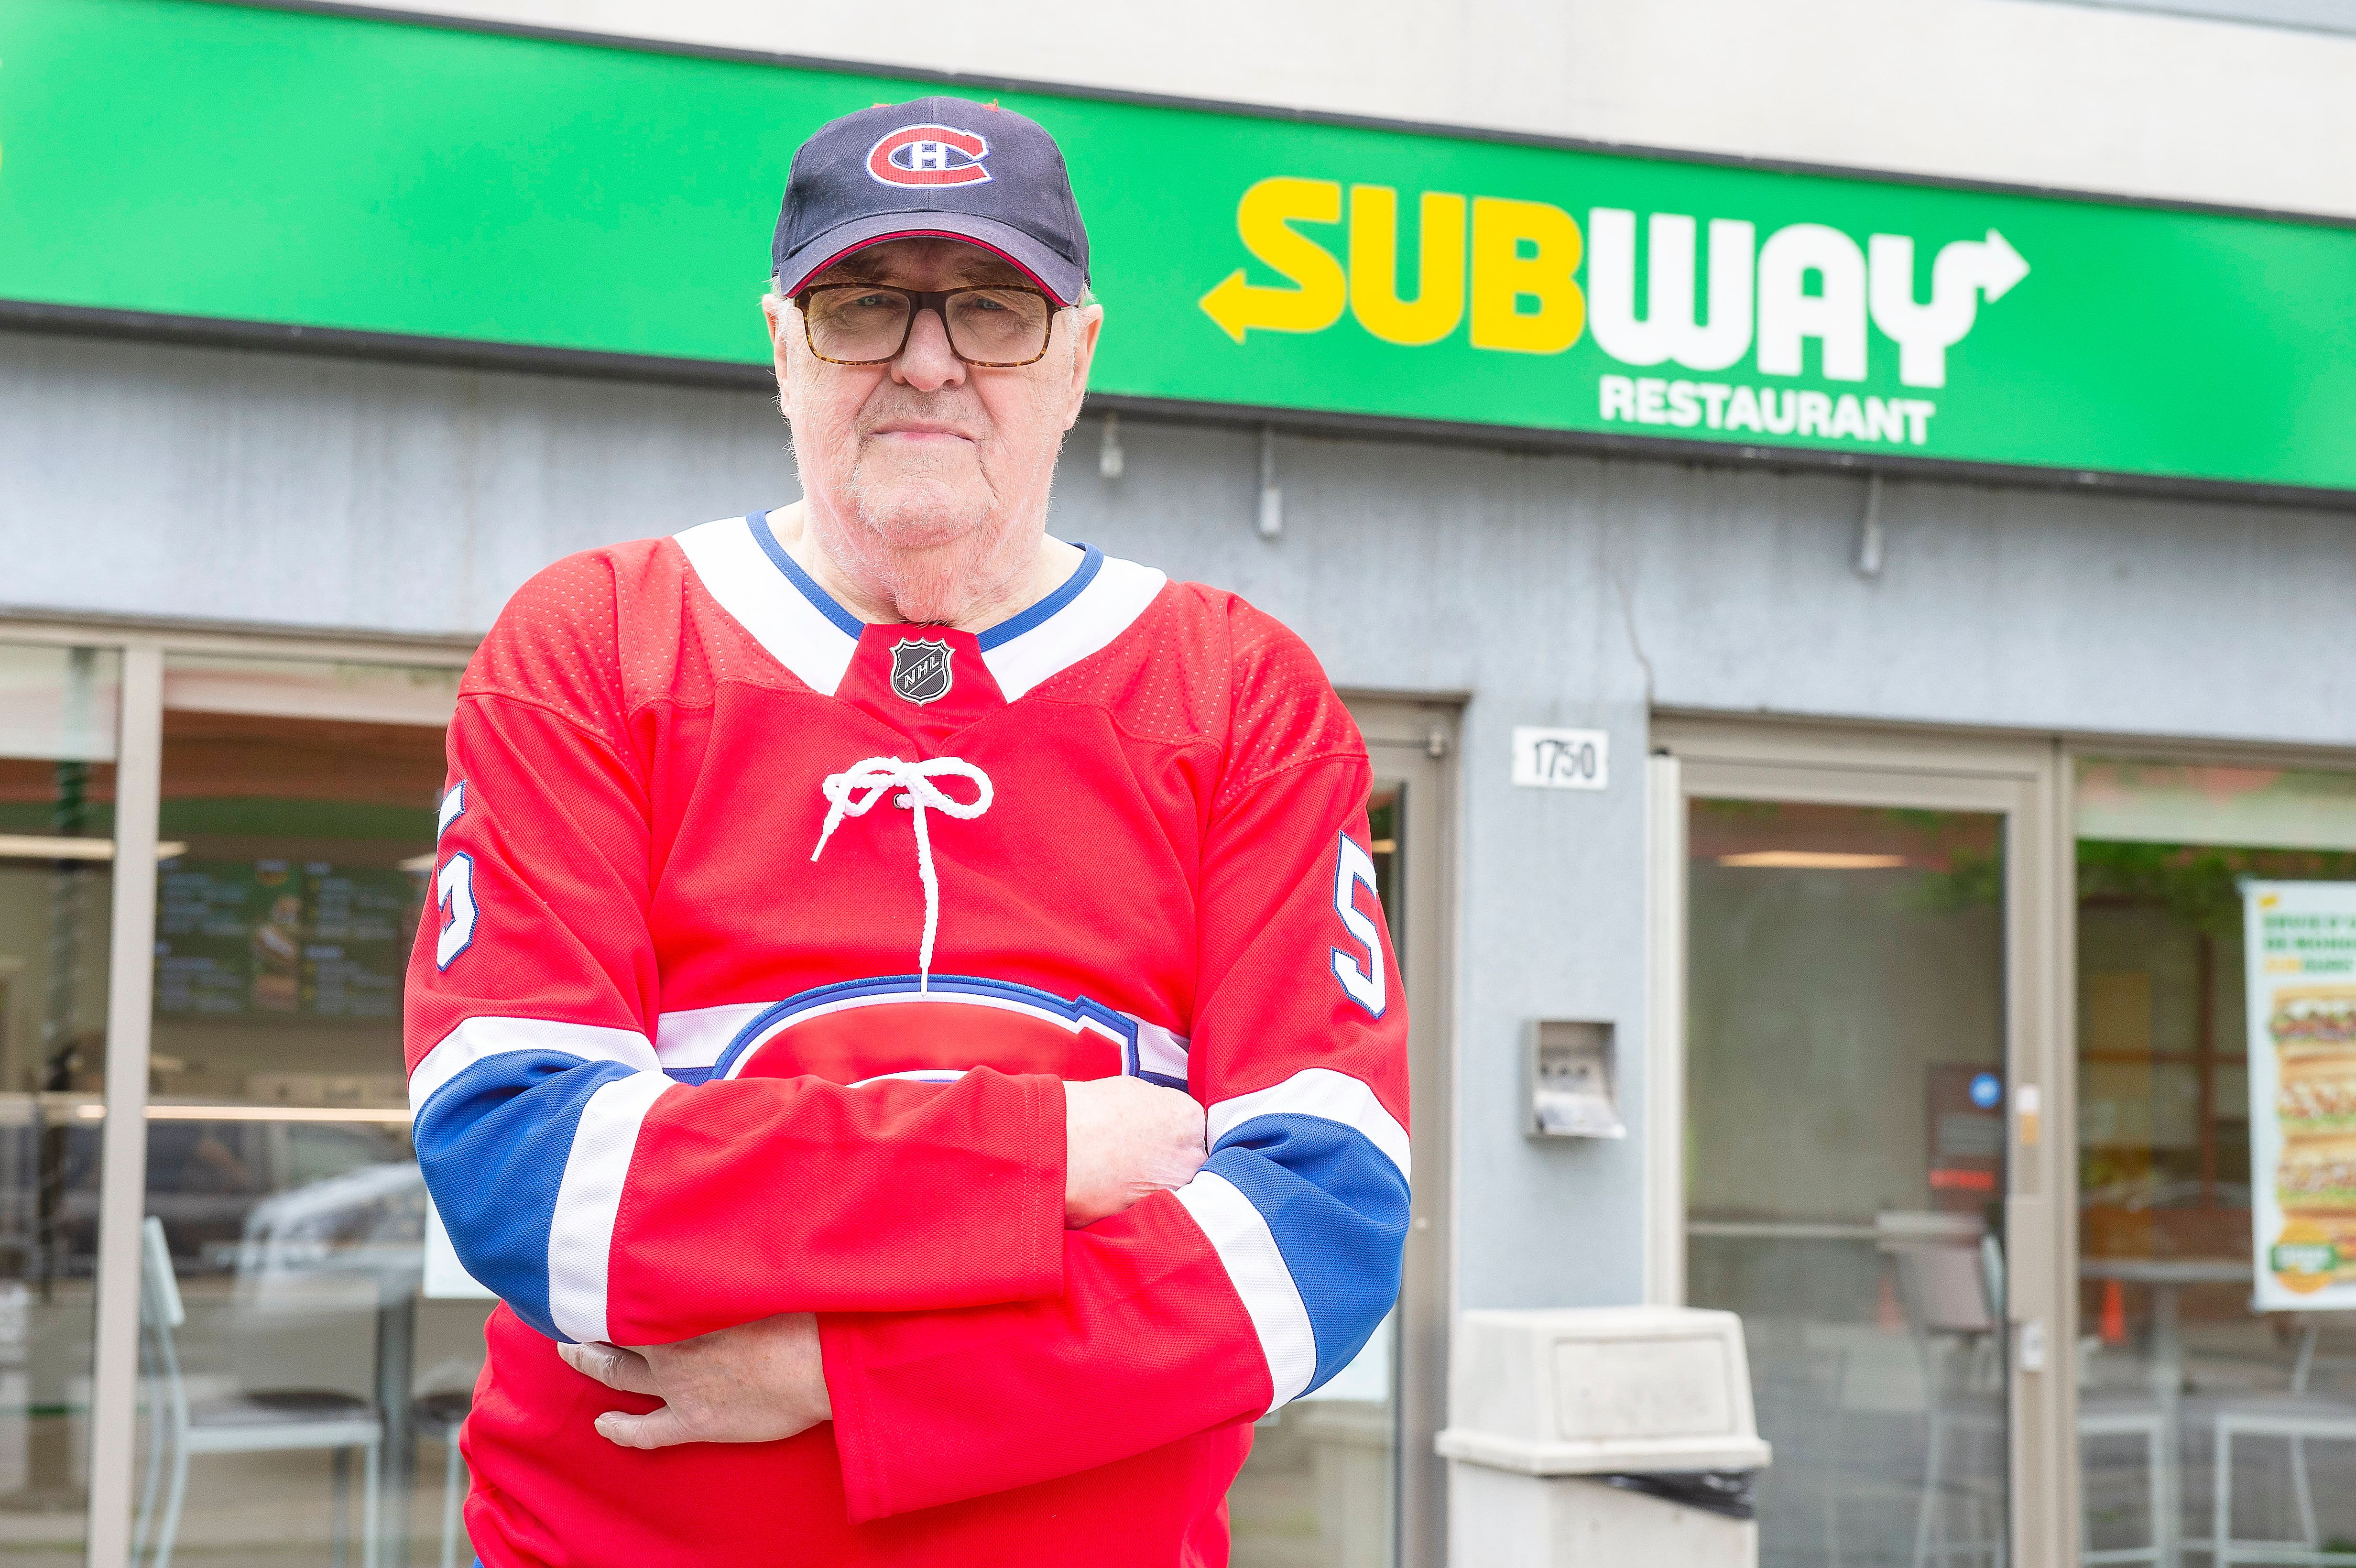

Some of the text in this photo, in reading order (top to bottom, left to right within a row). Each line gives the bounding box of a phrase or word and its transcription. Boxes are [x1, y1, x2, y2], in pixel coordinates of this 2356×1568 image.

[1198, 176, 2031, 389] SUBWAY
[1600, 375, 1936, 445] RESTAURANT
[904, 655, 939, 689] NHL
[1534, 739, 1595, 779] 1750
[1331, 830, 1386, 1020] 5
